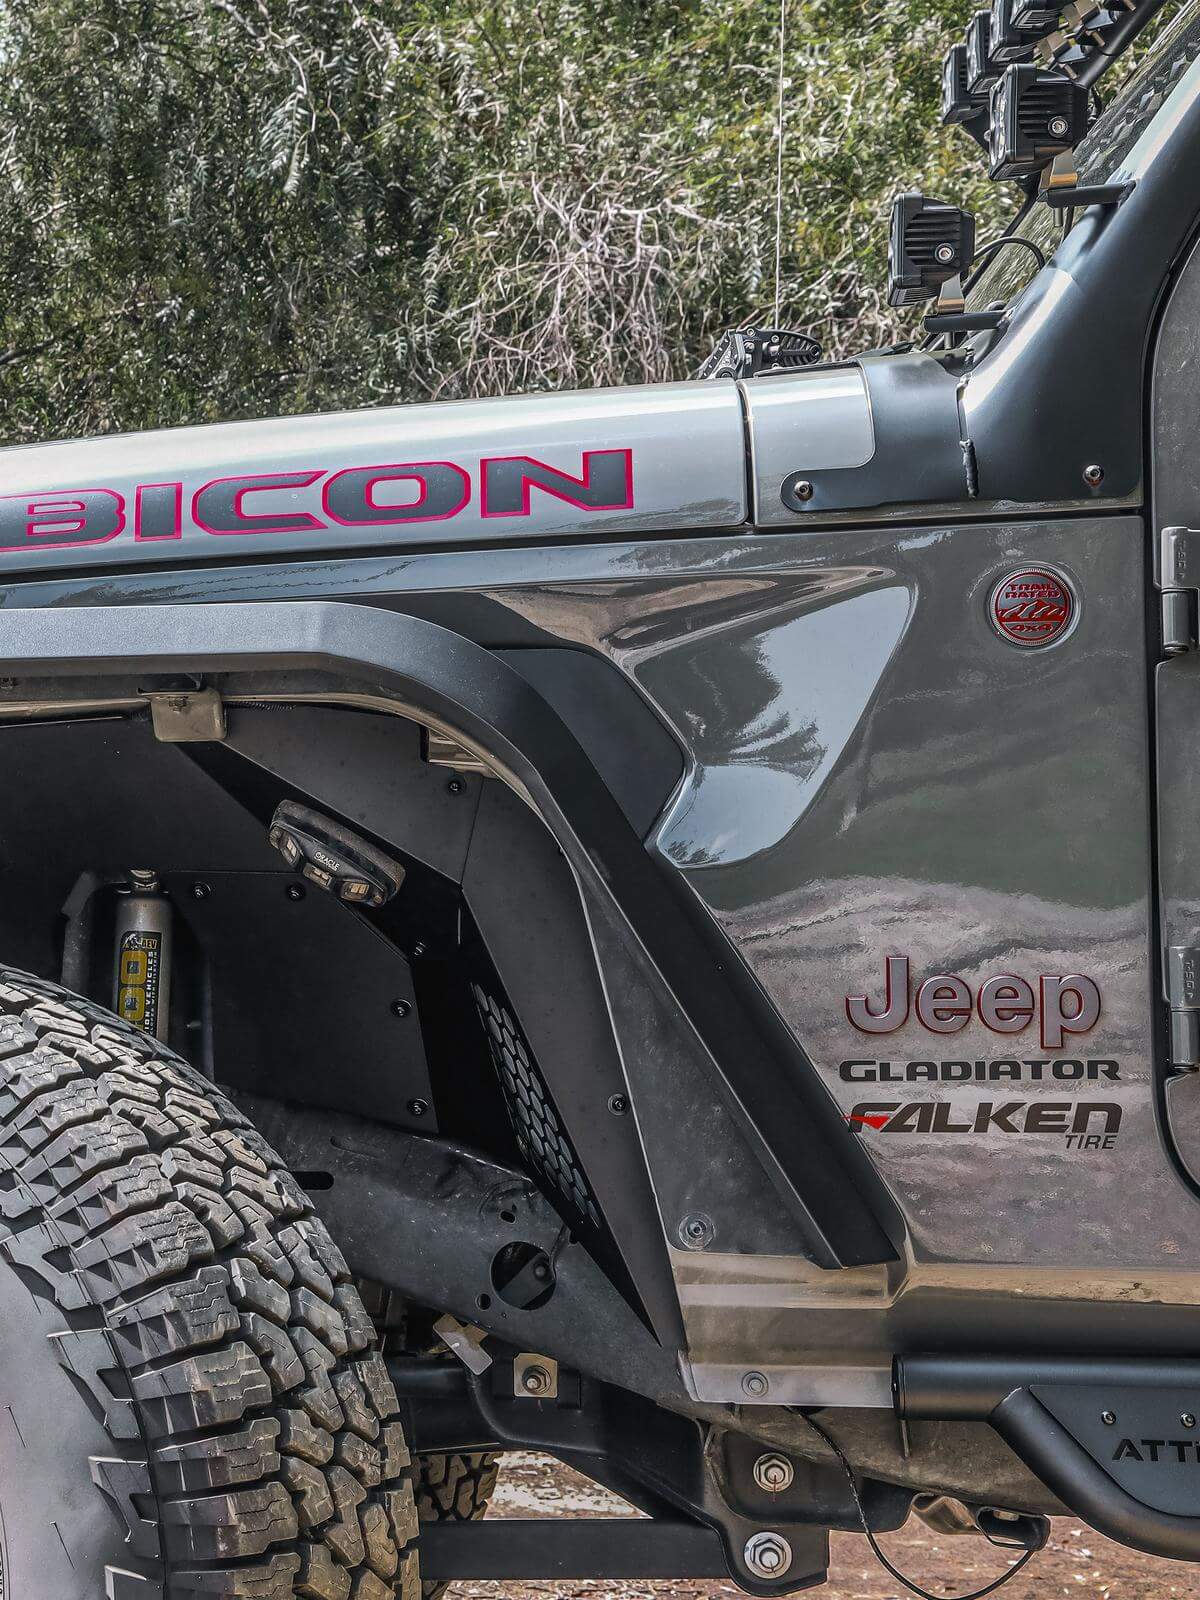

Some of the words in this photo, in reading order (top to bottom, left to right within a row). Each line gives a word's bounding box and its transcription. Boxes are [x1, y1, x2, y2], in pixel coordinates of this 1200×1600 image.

[1005, 590, 1061, 599] RATED
[1009, 583, 1056, 591] TRAIL
[315, 851, 341, 870] ORACLE
[145, 951, 154, 1006] VEHICLES
[845, 956, 1102, 1050] Jeep
[839, 1060, 1123, 1082] GLADIATOR
[842, 1102, 1123, 1134] FALKEN
[1065, 1134, 1118, 1150] TIRE
